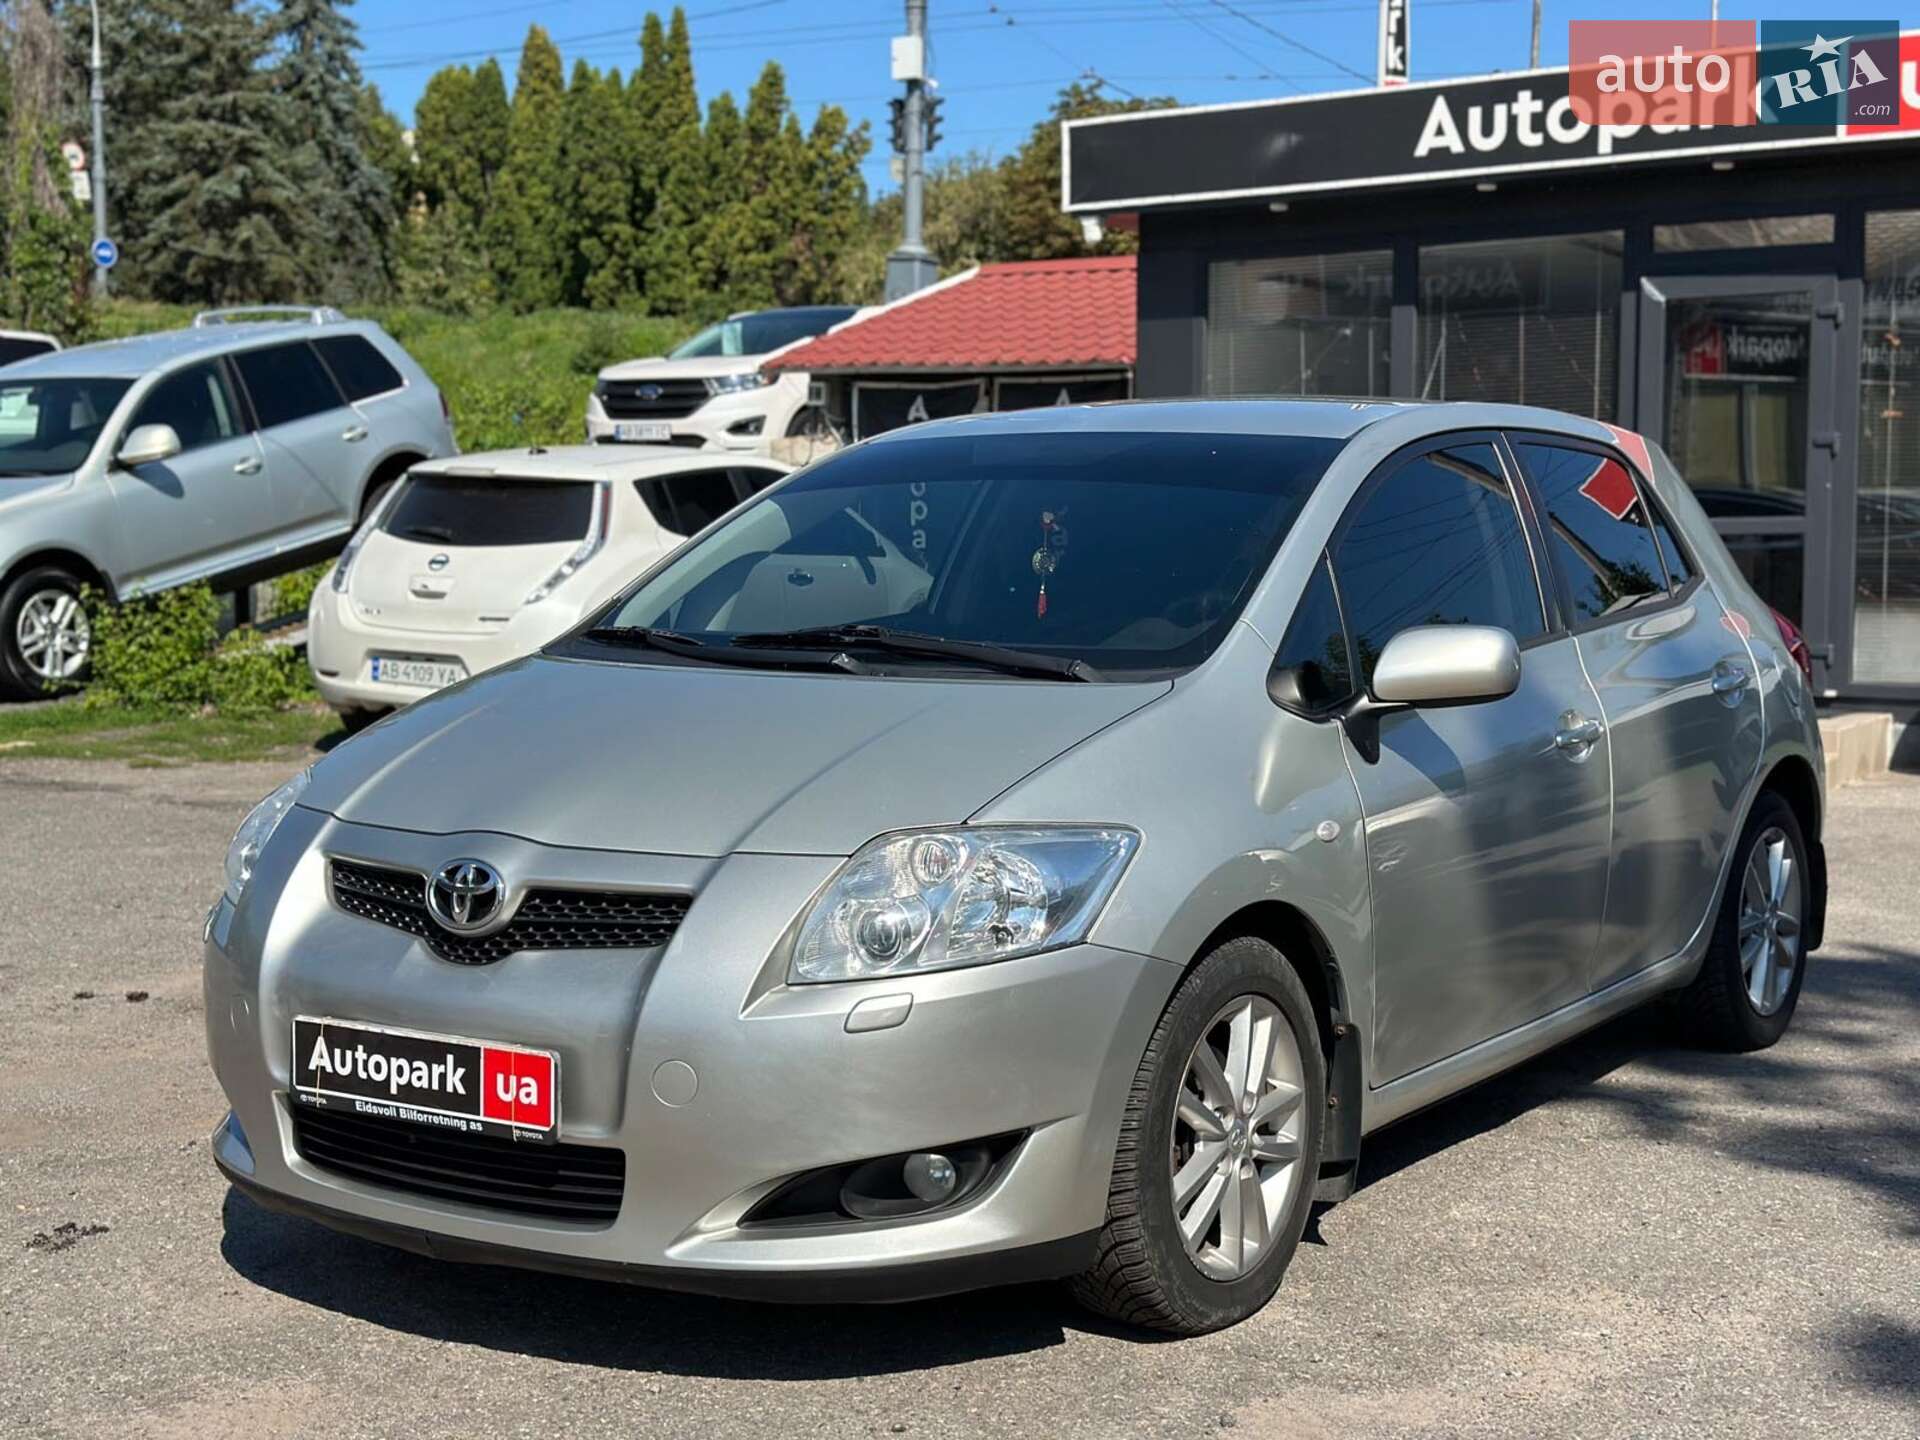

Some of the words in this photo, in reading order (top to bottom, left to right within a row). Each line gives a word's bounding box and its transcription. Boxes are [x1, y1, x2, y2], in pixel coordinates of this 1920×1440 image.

[1413, 54, 1780, 156] Autopark
[381, 664, 398, 680] AB
[402, 666, 433, 683] 4109
[308, 1035, 467, 1096] Autopark
[496, 1072, 539, 1106] ua
[355, 1101, 397, 1118] Eidsvoll
[399, 1107, 468, 1131] Bilforretning
[470, 1121, 483, 1132] as
